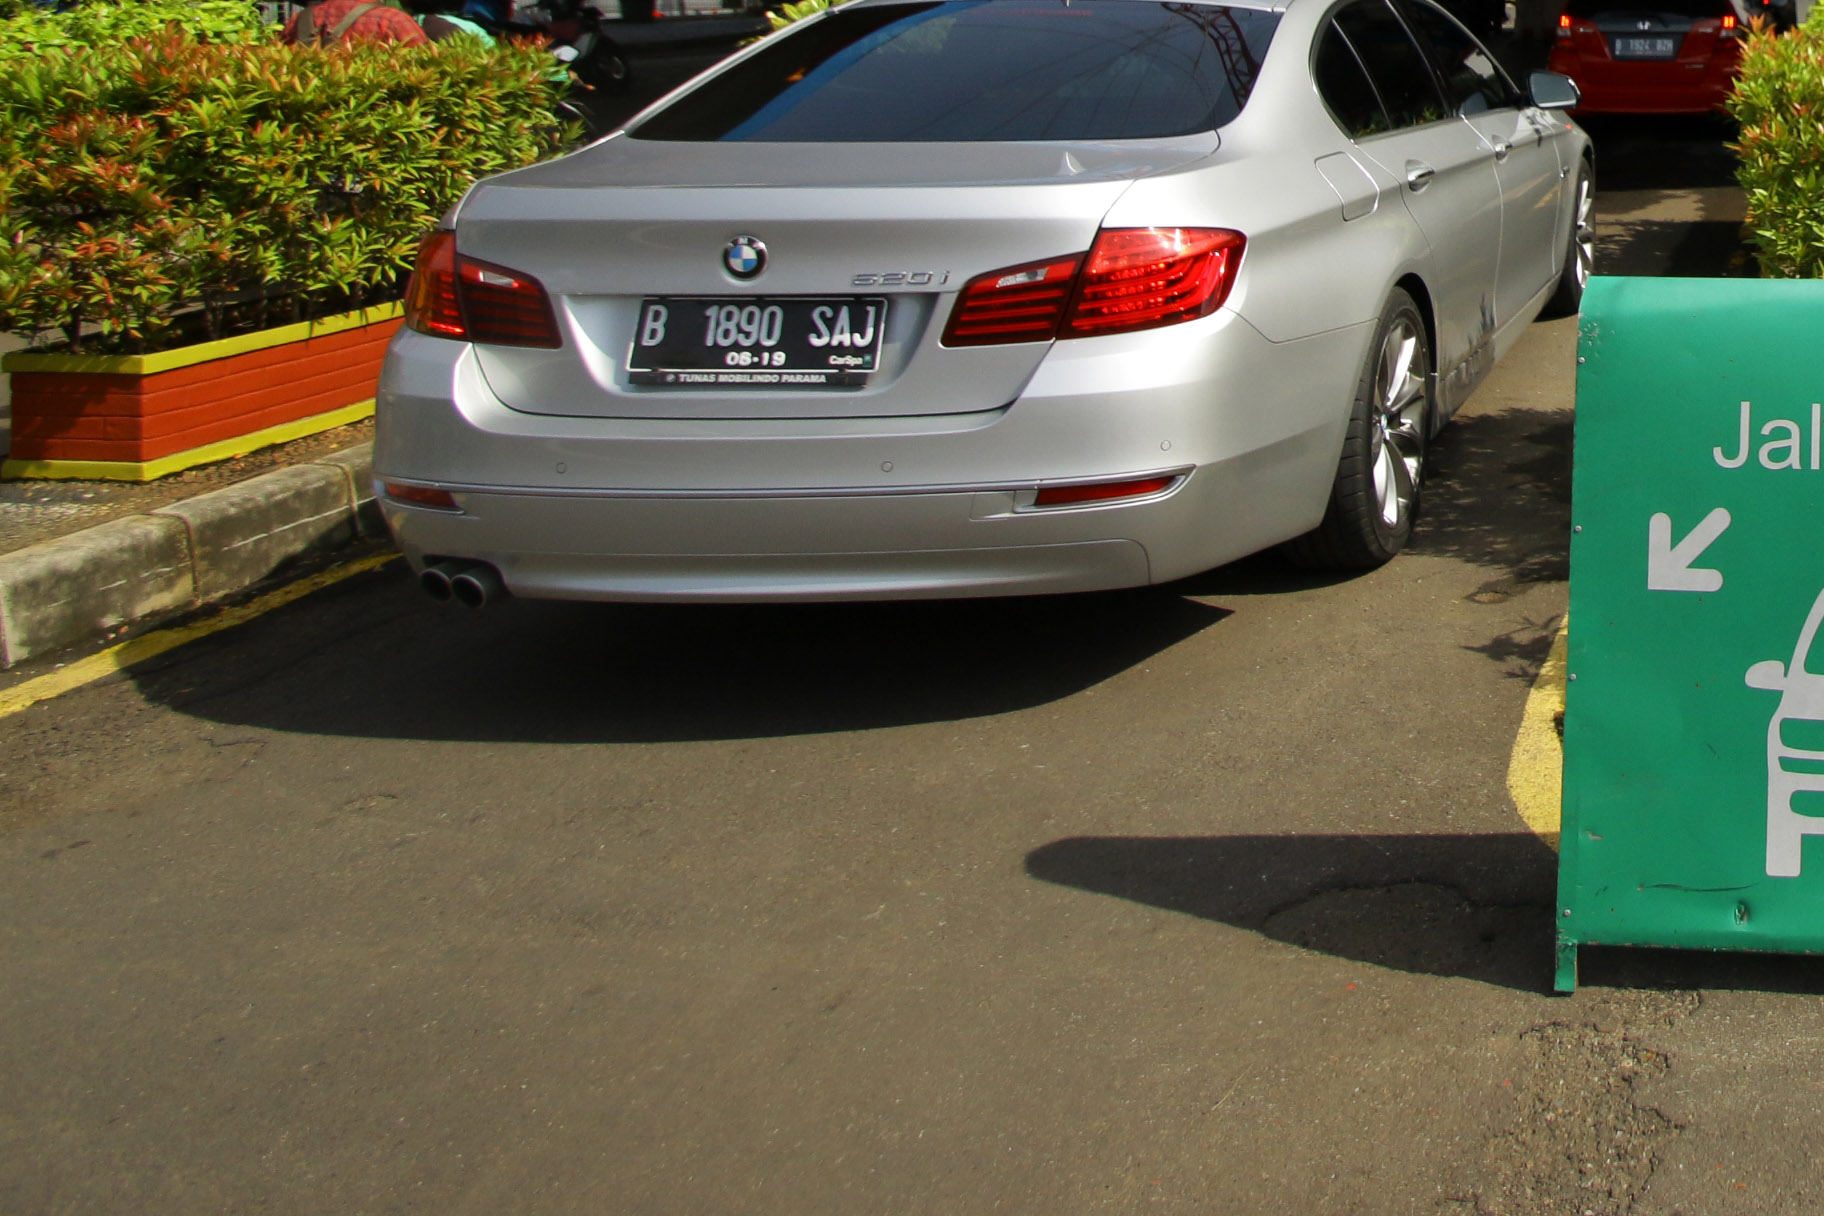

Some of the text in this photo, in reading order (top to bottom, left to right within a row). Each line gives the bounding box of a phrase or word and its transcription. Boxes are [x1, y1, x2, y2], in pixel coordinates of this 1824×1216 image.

[640, 304, 877, 347] B 1890 SAJ
[829, 355, 863, 366] CarSpa
[679, 374, 827, 383] TUNAS MOBILINDO PARAMA
